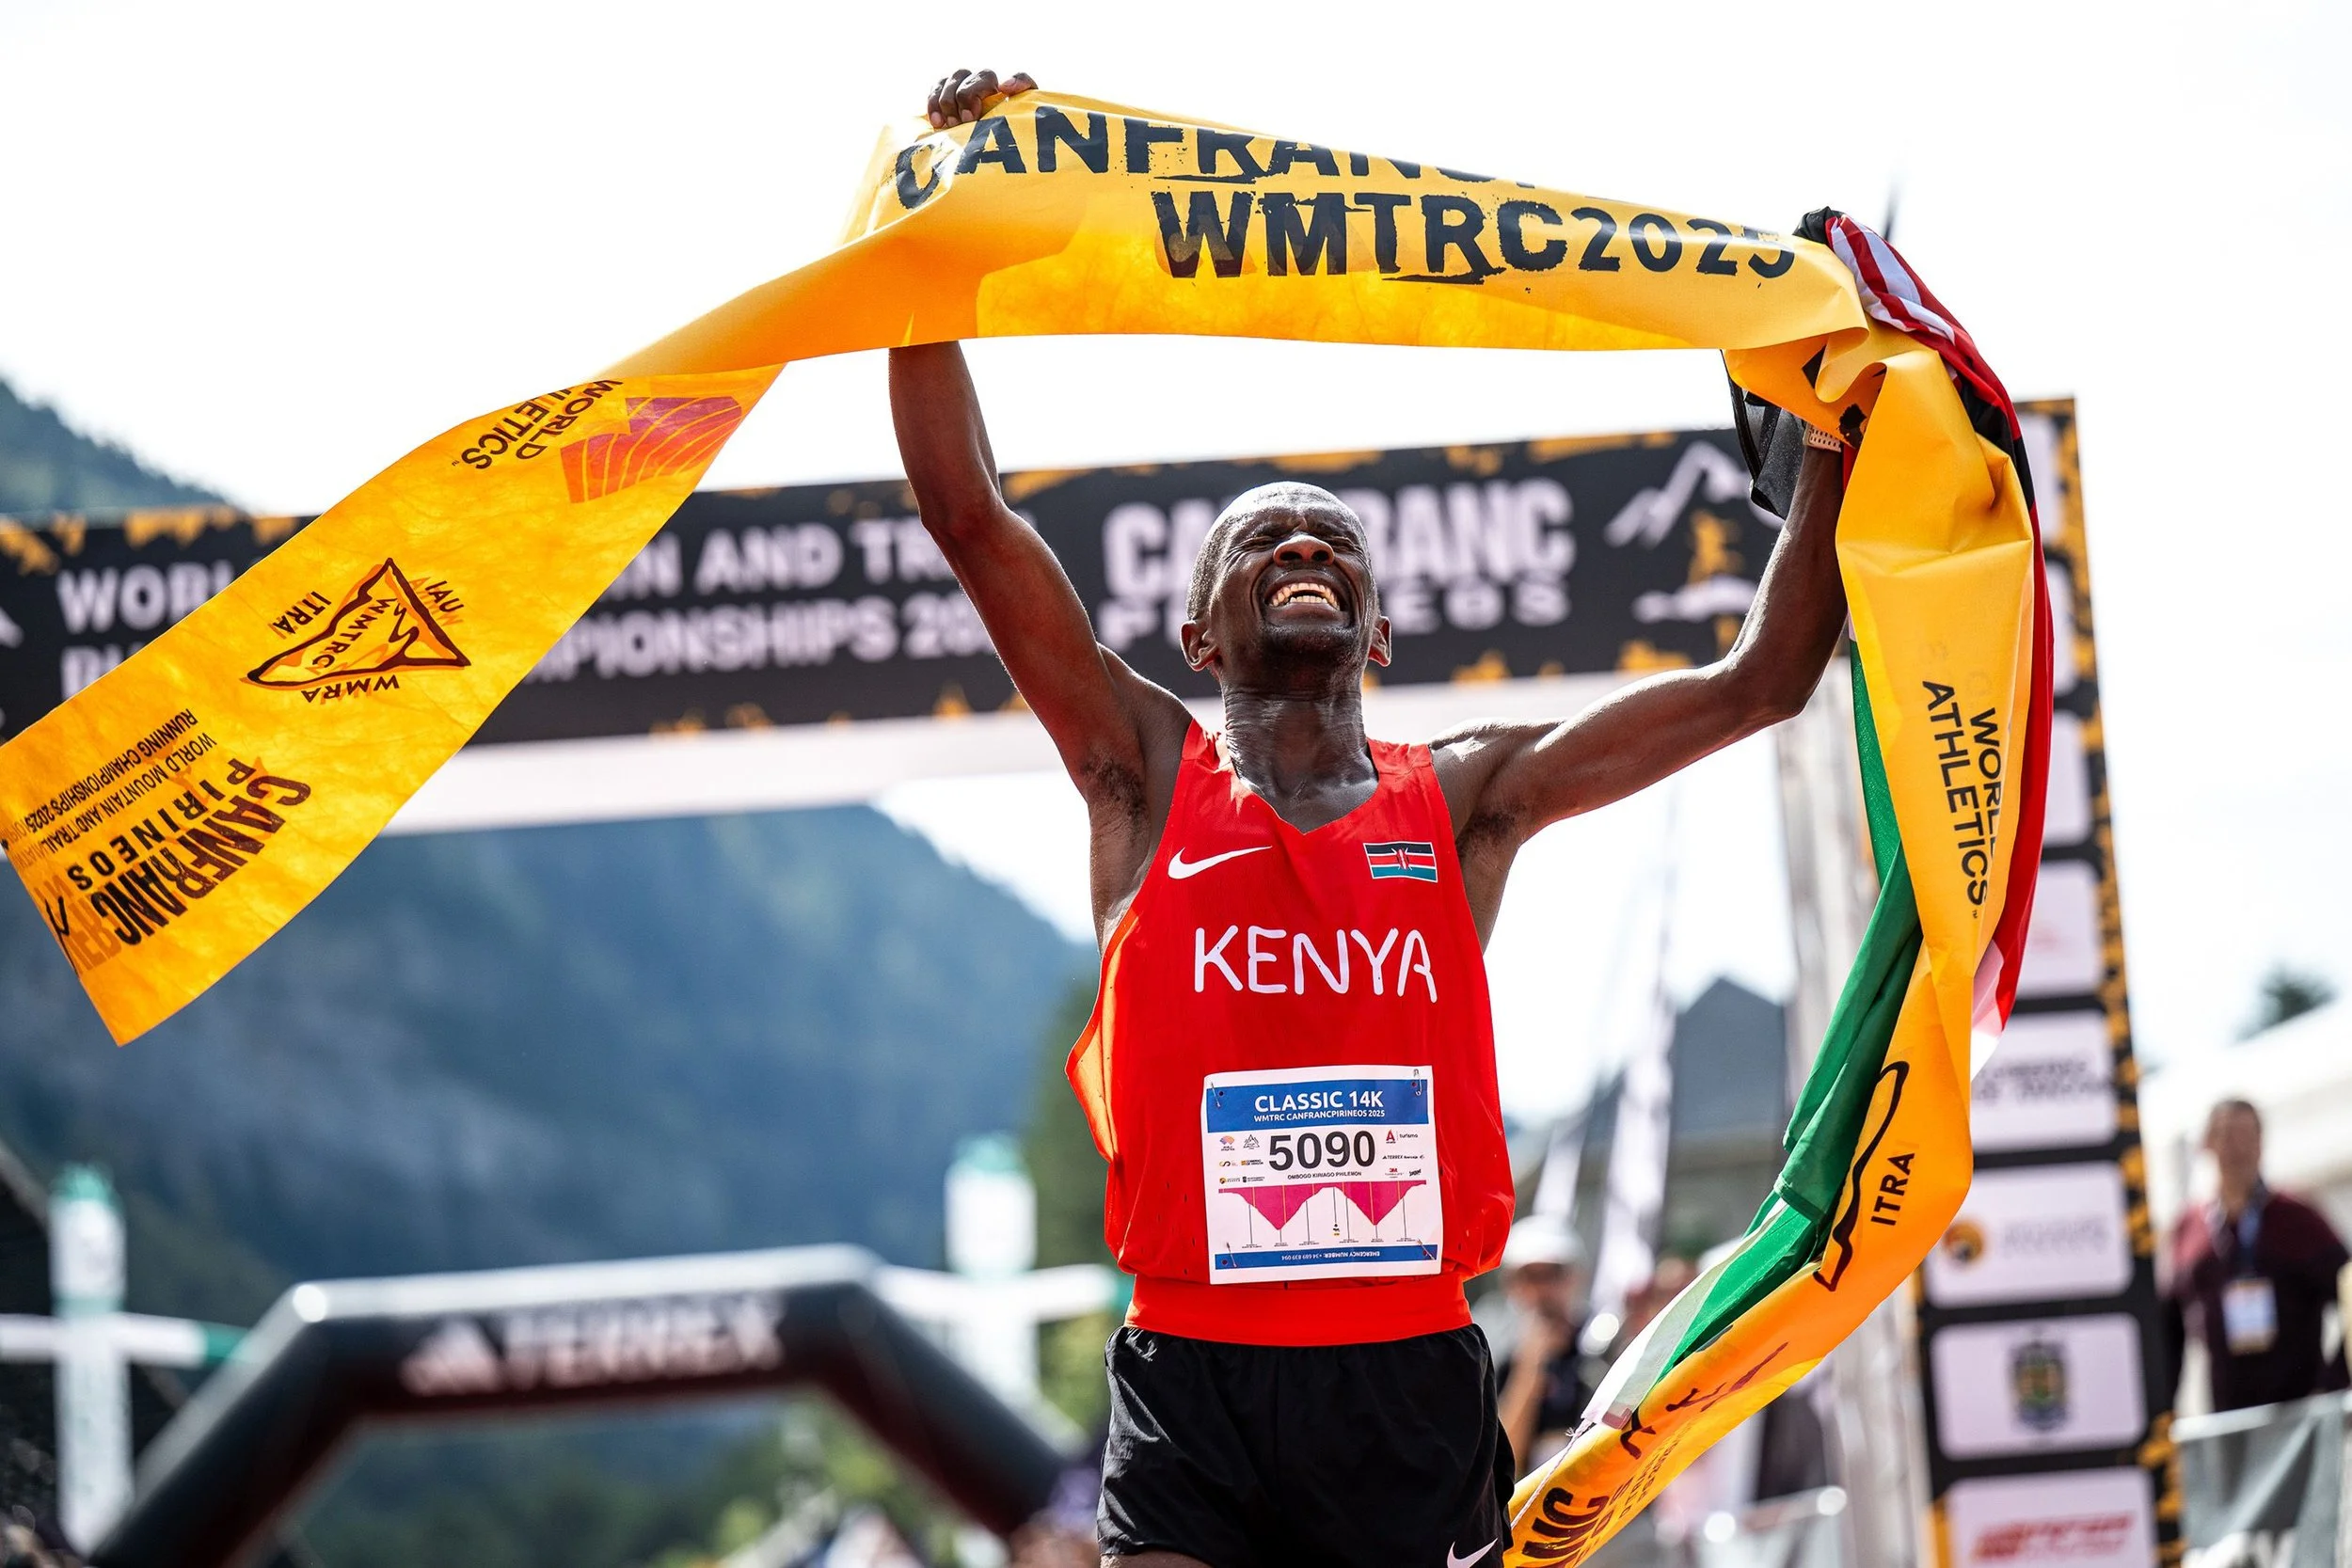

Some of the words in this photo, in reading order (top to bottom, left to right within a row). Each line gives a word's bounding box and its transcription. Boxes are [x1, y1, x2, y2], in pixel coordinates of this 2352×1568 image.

[895, 105, 1498, 209] CANFRA
[1151, 191, 1795, 284] WMTRC2025
[516, 379, 623, 459] WORLD
[694, 522, 843, 596] AND
[273, 591, 332, 634] ITRA
[424, 580, 465, 612] IAU
[312, 597, 398, 669] WMTRC
[300, 674, 400, 703] WMRA
[137, 708, 199, 757] RUNNING
[166, 733, 217, 772] WORLD
[50, 749, 142, 816] CHAMPIONSHIPS
[100, 765, 169, 817] MOUNTAIN
[1922, 680, 1989, 907] ATHLETICS
[25, 805, 56, 833] 2025
[45, 825, 81, 853] TRAIL
[67, 758, 257, 891] PIRINEOS
[75, 806, 103, 833] AND
[91, 775, 311, 945] CANFRANC
[1194, 925, 1438, 1003] KENYA
[1254, 1091, 1343, 1113] CLASSIC
[1349, 1090, 1384, 1108] 14K
[1254, 1114, 1284, 1122] WMTRC
[1286, 1110, 1368, 1121] CANFRANCPIRINEOS
[1368, 1109, 1385, 1117] 2025
[1269, 1131, 1375, 1171] 5090
[1870, 1152, 1915, 1227] ITRA
